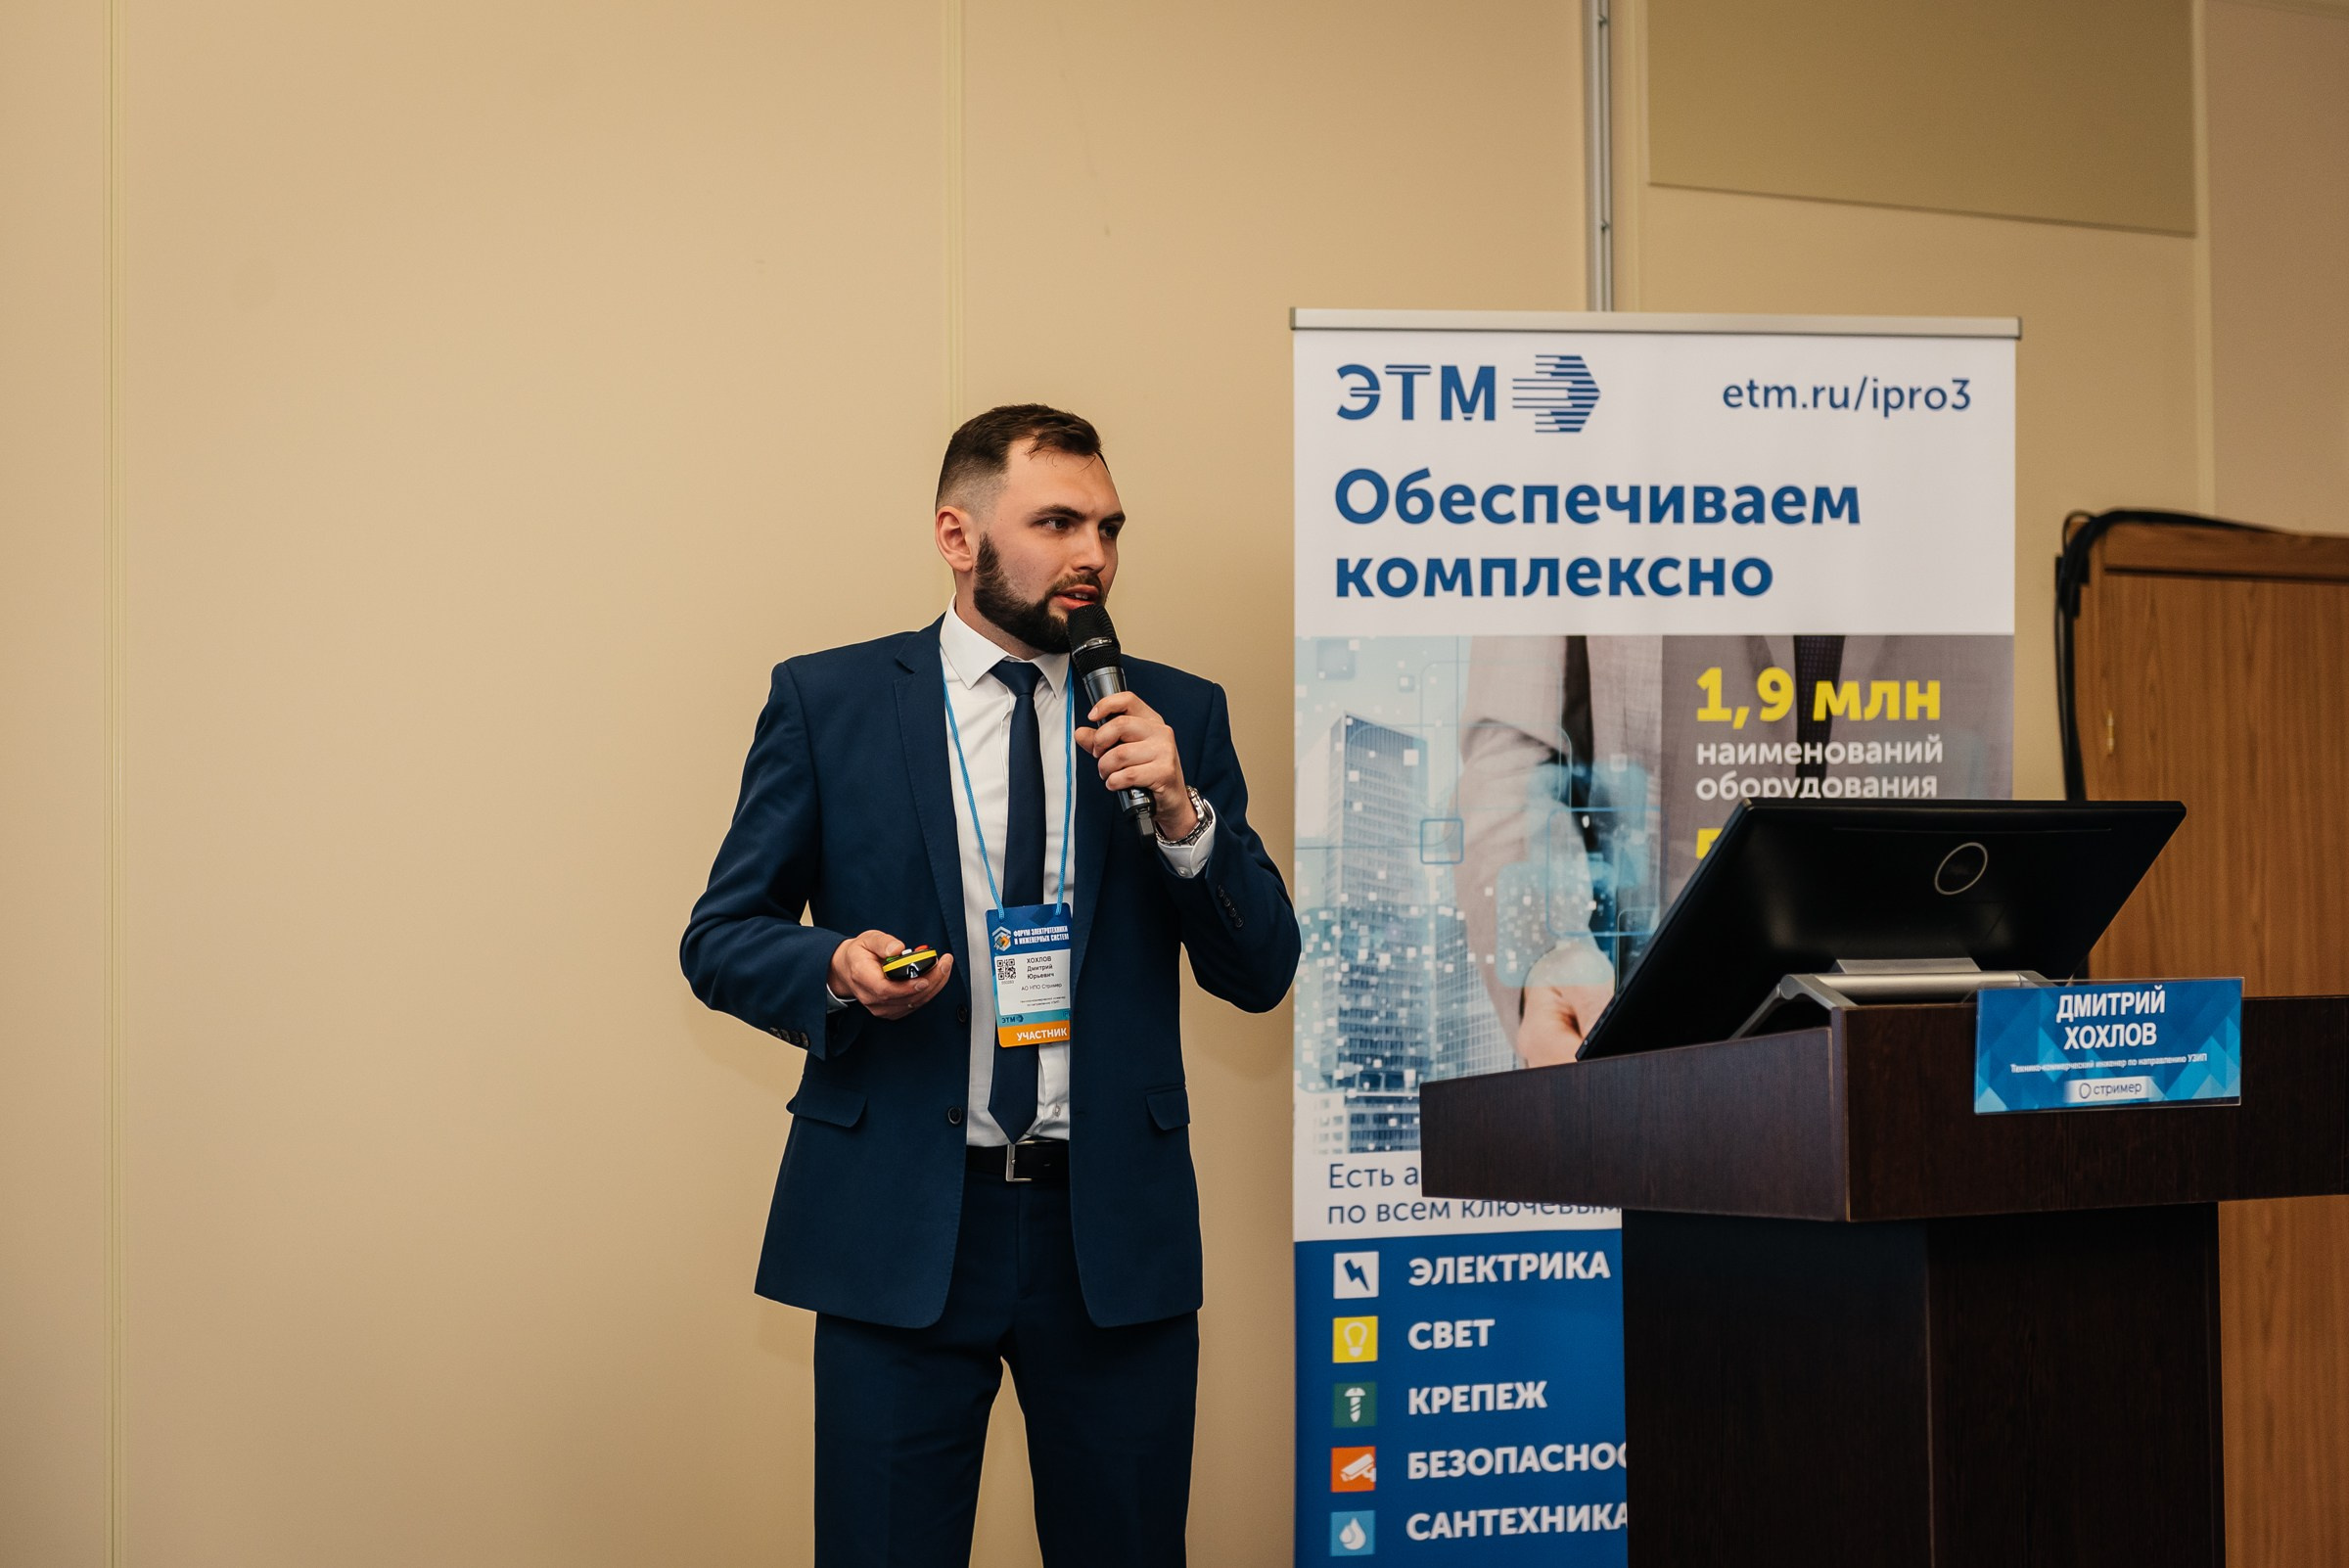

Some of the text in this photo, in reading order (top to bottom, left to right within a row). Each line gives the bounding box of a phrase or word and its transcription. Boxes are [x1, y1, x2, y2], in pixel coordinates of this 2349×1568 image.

[1335, 363, 1497, 421] ЭТМ
[1722, 376, 1972, 418] etm.ru/ipro3
[1335, 468, 1862, 526] Обеспечиваем
[1335, 555, 1773, 599] комплексно
[1696, 667, 1942, 729] 1,9 млн
[1696, 734, 1944, 766] наименований
[1696, 770, 1938, 801] оборудования
[2055, 985, 2166, 1023] ДМИТРИЙ
[1016, 1028, 1067, 1041] УЧАСТНИК
[2063, 1023, 2157, 1050] ХОХЛОВ
[2094, 1083, 2142, 1096] стример
[1329, 1163, 1395, 1188] Есть
[1328, 1205, 1366, 1223] по
[1376, 1201, 1451, 1222] всем
[1407, 1251, 1611, 1286] ЭЛЕКТРИКА
[1407, 1318, 1496, 1351] СВЕТ
[1407, 1381, 1547, 1415] КРЕПЕЖ
